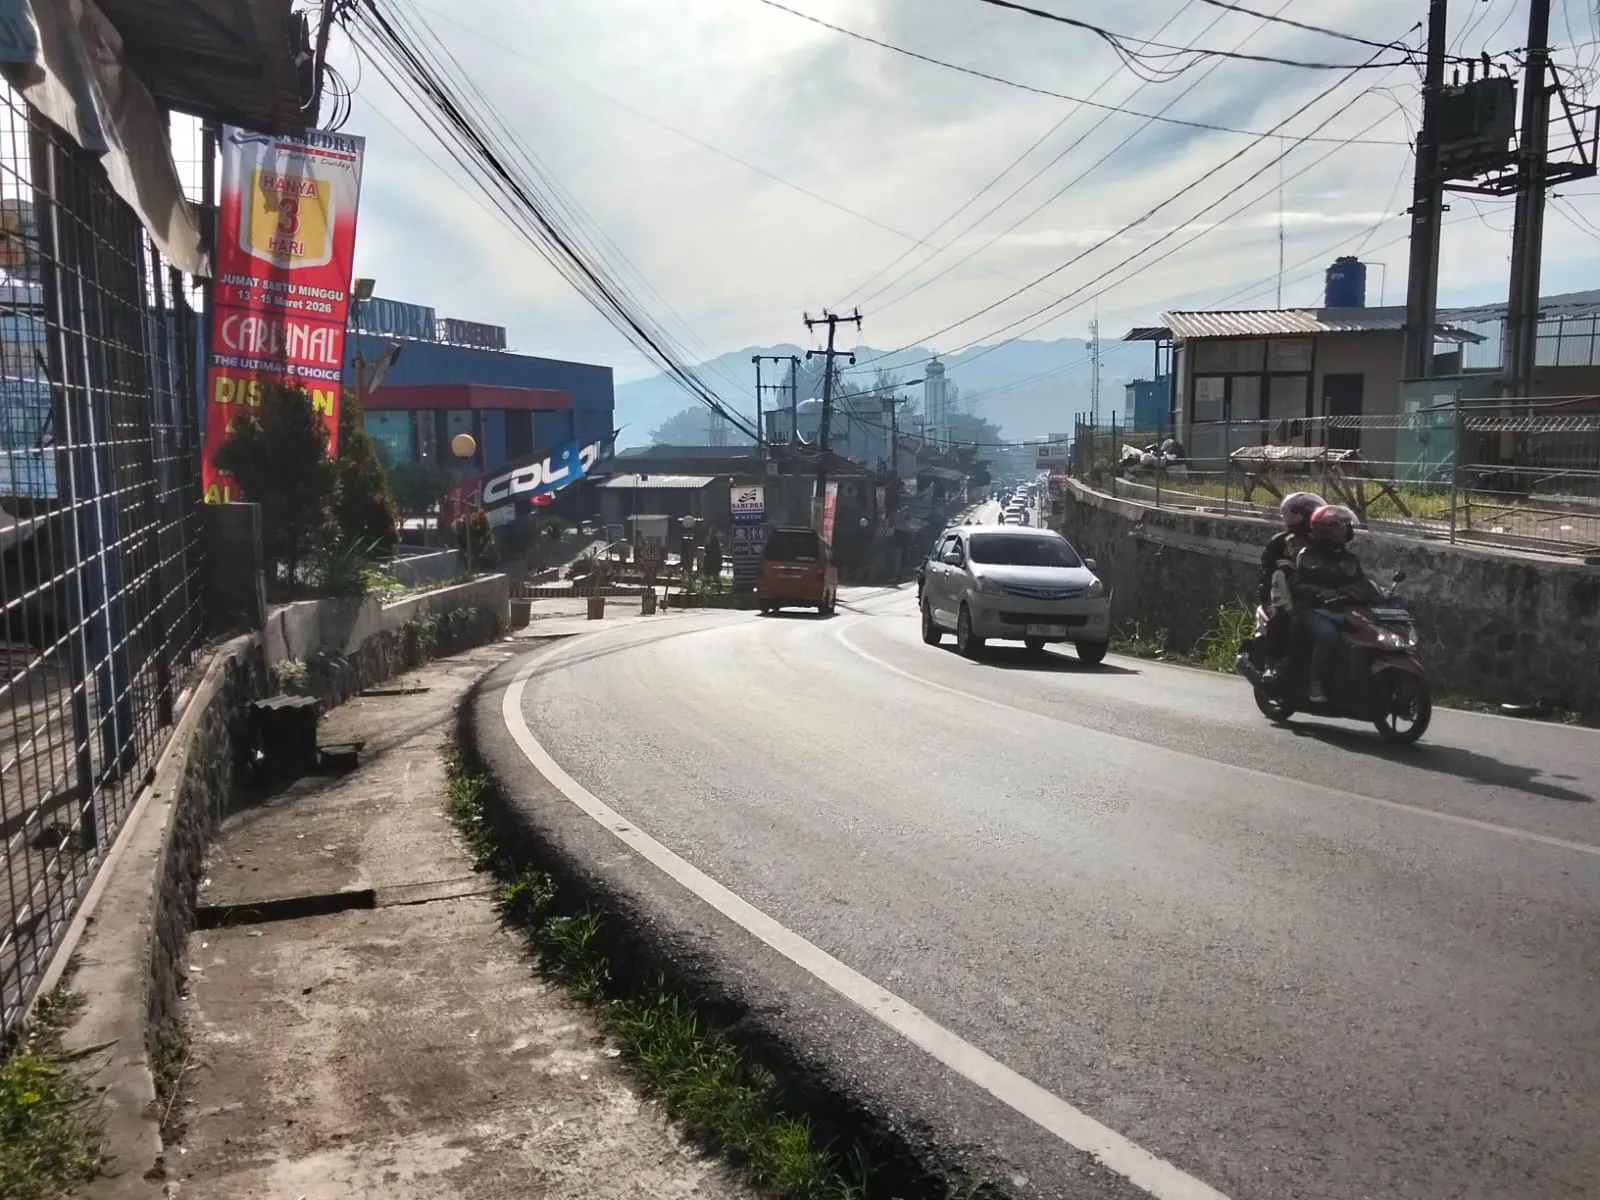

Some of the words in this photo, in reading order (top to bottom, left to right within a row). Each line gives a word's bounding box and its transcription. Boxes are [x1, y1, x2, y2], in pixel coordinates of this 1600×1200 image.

[262, 176, 317, 198] HANYA
[277, 196, 300, 237] 3
[268, 237, 304, 256] HARI
[219, 273, 260, 288] JUMAT
[262, 279, 296, 294] SABTU
[298, 285, 344, 302] MINGGU
[238, 289, 250, 301] 13
[260, 292, 271, 304] 15
[274, 296, 304, 310] Maret
[305, 299, 333, 314] 2026
[213, 354, 237, 367] THE
[240, 357, 296, 375] ULTIMAE
[296, 365, 341, 381] CHOICE
[215, 376, 335, 417] DISN
